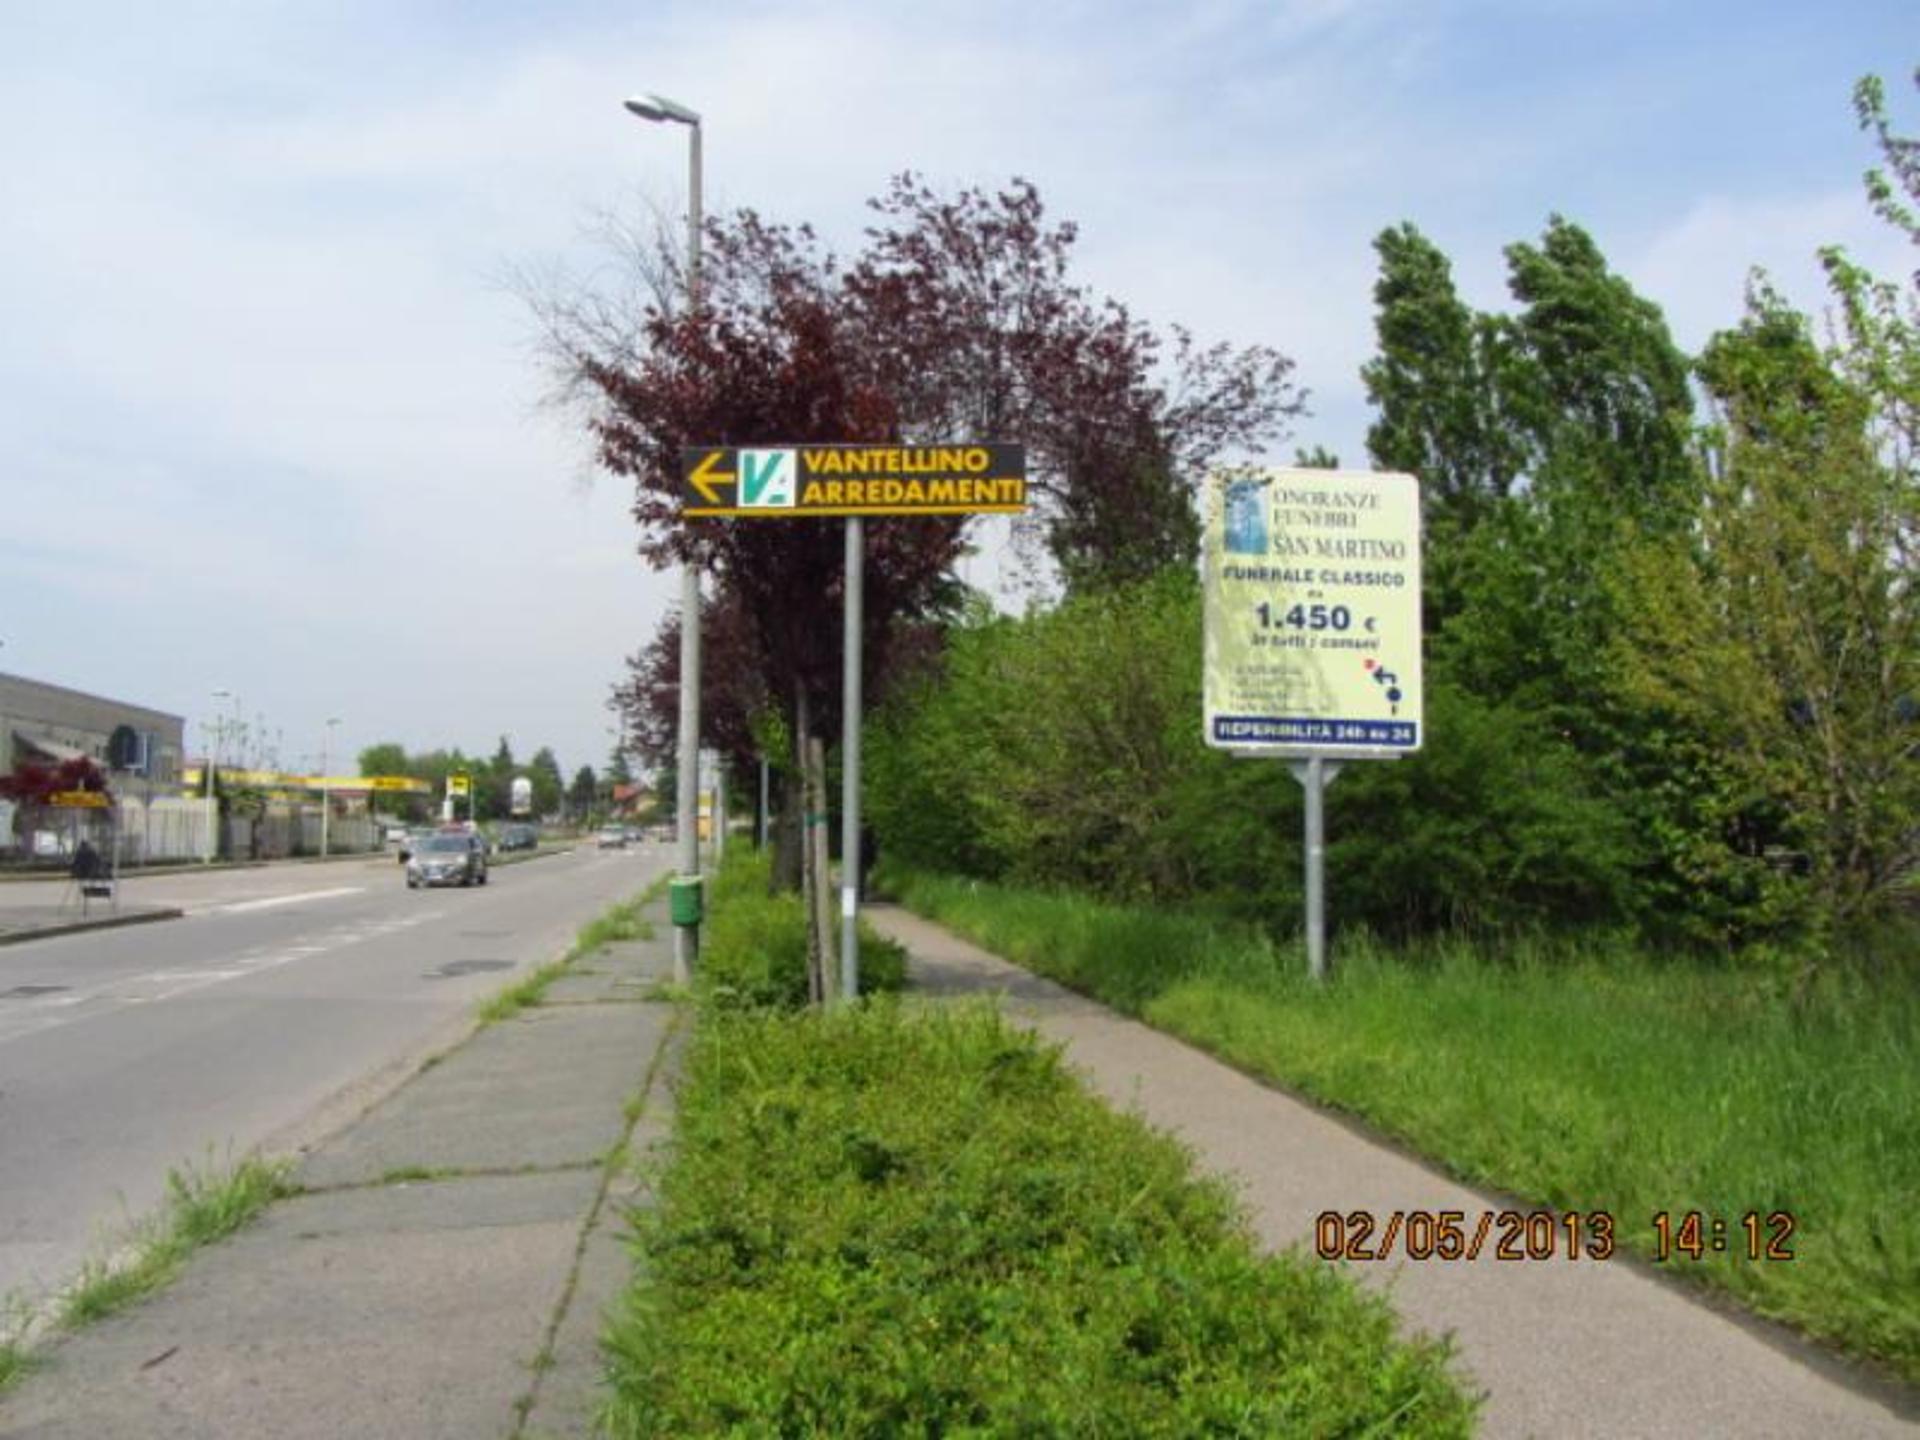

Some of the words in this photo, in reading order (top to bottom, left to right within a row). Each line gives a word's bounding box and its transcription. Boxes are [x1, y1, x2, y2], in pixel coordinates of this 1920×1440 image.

[802, 449, 990, 473] VANTELLINO
[802, 478, 1024, 504] ARREDAMENTI
[1273, 489, 1381, 509] ONORANZE
[1273, 508, 1358, 528] FUNEBRI
[1273, 534, 1310, 556] SAN
[1314, 537, 1406, 560] MARTINO
[1224, 566, 1315, 584] FUNERALE
[1320, 569, 1405, 587] CLASSICO
[1256, 602, 1351, 630] 1.450
